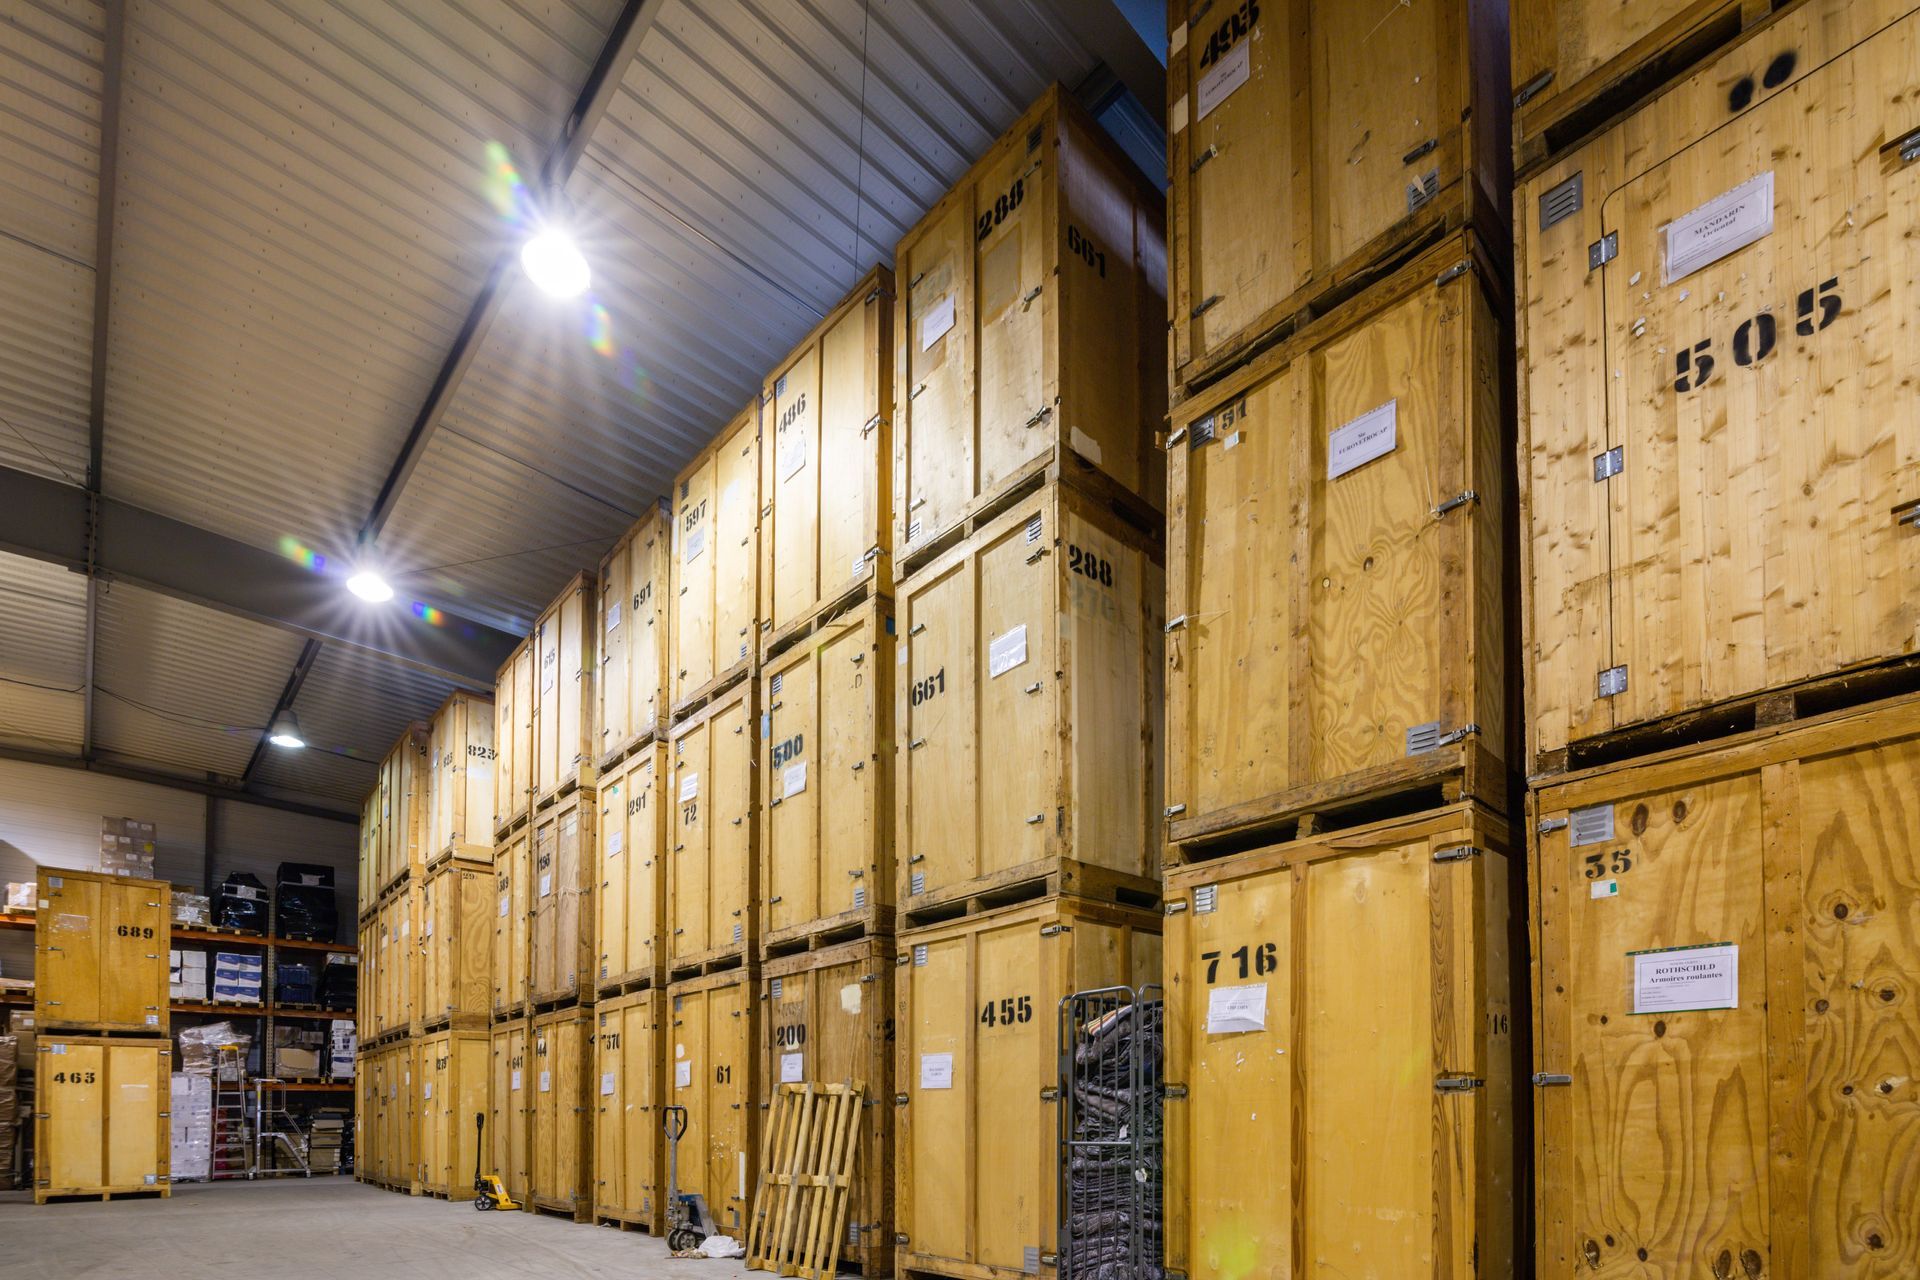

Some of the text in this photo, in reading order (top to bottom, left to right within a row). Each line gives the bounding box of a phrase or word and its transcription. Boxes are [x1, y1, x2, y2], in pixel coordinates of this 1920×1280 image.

[978, 179, 1024, 242] 288
[1693, 204, 1746, 236] MANDARIN
[1703, 216, 1736, 239] Oriental
[1068, 225, 1105, 278] 661
[1674, 276, 1842, 393] 505
[779, 392, 806, 434] 486
[685, 498, 707, 532] 597
[1069, 544, 1113, 588] 288
[633, 580, 653, 610] 691
[912, 666, 944, 707] 661
[467, 744, 496, 761] 823
[774, 733, 803, 770] 500
[629, 791, 646, 816] 291
[683, 803, 697, 826] 72
[1585, 849, 1632, 879] 35
[117, 925, 154, 939] 689
[1201, 943, 1277, 985] 716
[1649, 975, 1685, 984] Armoires
[1686, 972, 1723, 982] roulantes
[1655, 963, 1716, 975] ROTHSCHILD
[981, 995, 1033, 1028] 455
[776, 1023, 806, 1047] 200
[53, 1071, 96, 1084] 463
[716, 1065, 731, 1084] 61
